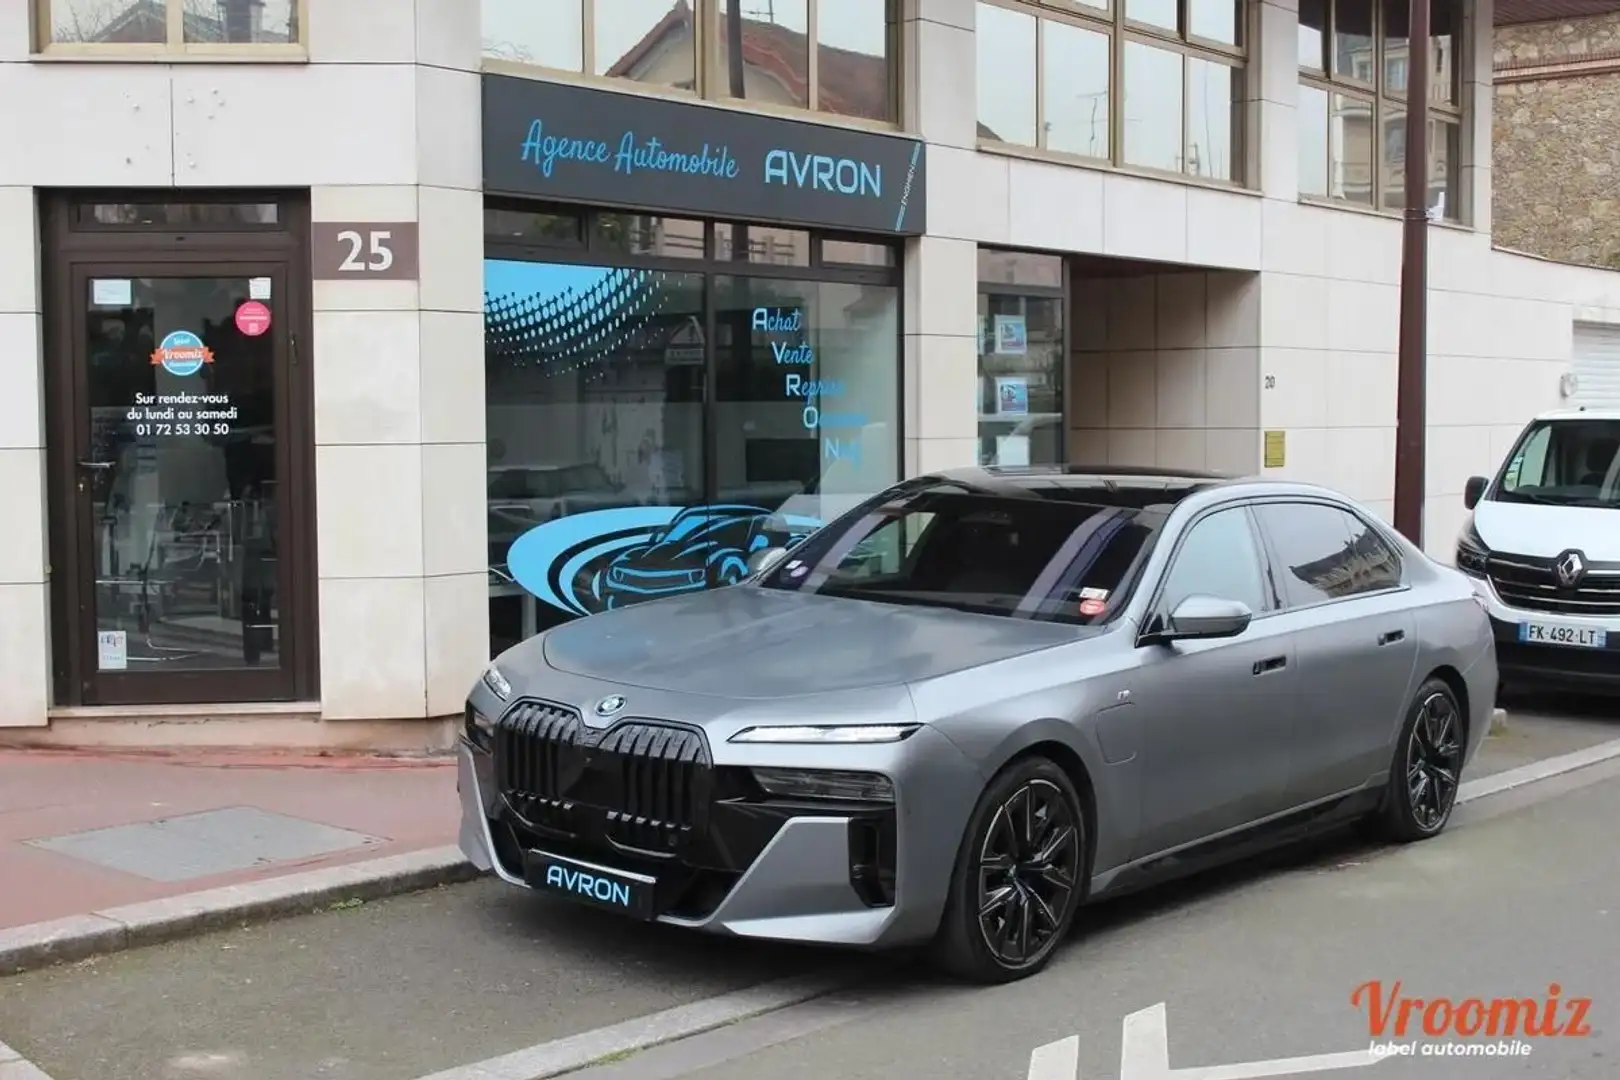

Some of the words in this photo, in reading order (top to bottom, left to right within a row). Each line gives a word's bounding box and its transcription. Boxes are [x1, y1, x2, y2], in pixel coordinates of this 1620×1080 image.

[521, 118, 610, 178] Agence
[614, 130, 739, 179] Automobile
[764, 149, 882, 198] AVRON
[337, 230, 393, 271] 25
[752, 308, 801, 331] Achat
[771, 340, 813, 364] Vente
[135, 392, 154, 404] Sur
[158, 391, 229, 404] rendez-vous
[127, 407, 143, 420] du
[146, 407, 175, 420] lundi
[178, 410, 193, 420] au
[196, 407, 238, 420] samedi
[136, 424, 151, 435] 01
[156, 424, 171, 435] 72
[175, 424, 190, 435] 53
[194, 424, 210, 435] 30
[213, 424, 230, 435] 50
[547, 865, 630, 907] AVRON
